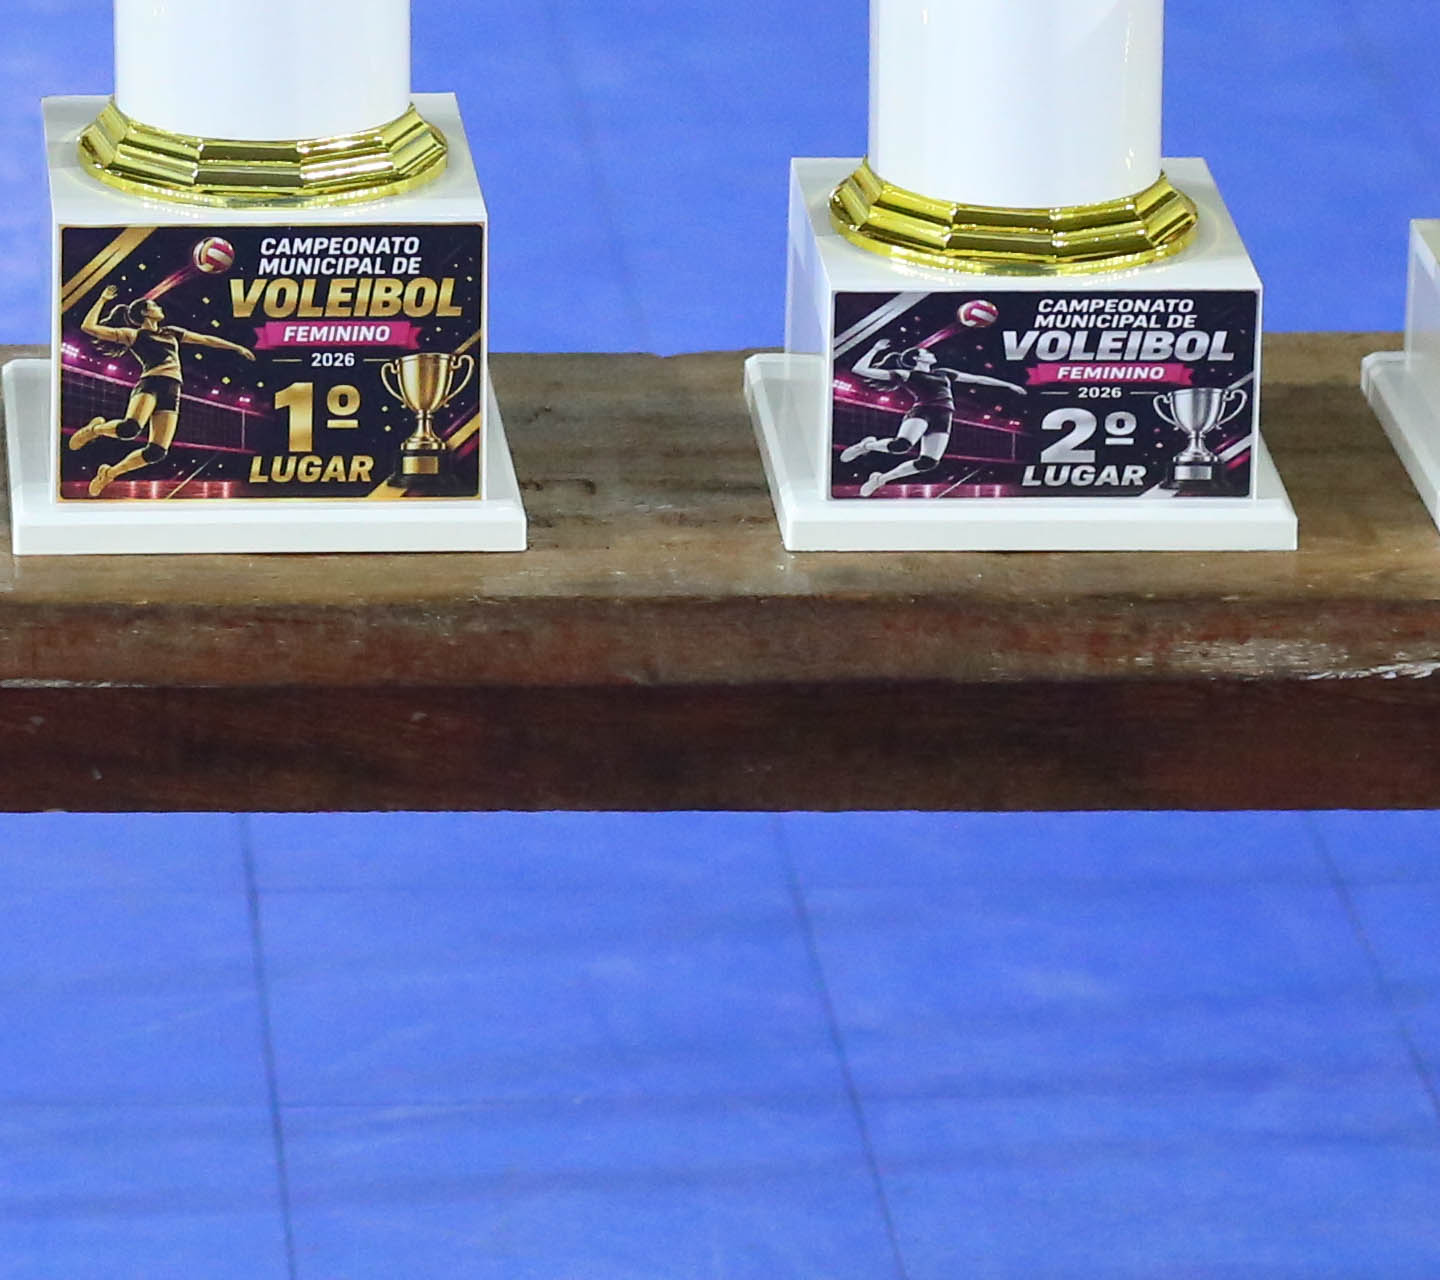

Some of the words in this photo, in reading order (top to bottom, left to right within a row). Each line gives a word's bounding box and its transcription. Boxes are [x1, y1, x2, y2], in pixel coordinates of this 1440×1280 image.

[260, 237, 420, 255] CAMPEONATO
[258, 257, 387, 275] MUNICIPAL
[392, 257, 421, 274] DE
[230, 277, 463, 318] VOLEIBOL
[1038, 298, 1194, 313] CAMPEONATO
[1035, 314, 1164, 328] MUNICIPAL
[1167, 315, 1196, 328] DE
[283, 325, 390, 342] FEMININO
[1002, 330, 1234, 361] VOLEIBOL
[311, 352, 355, 368] 2026
[1058, 366, 1165, 380] FEMININO
[1077, 386, 1122, 399] 2026
[249, 455, 374, 483] LUGAR
[1023, 464, 1146, 486] LUGAR
